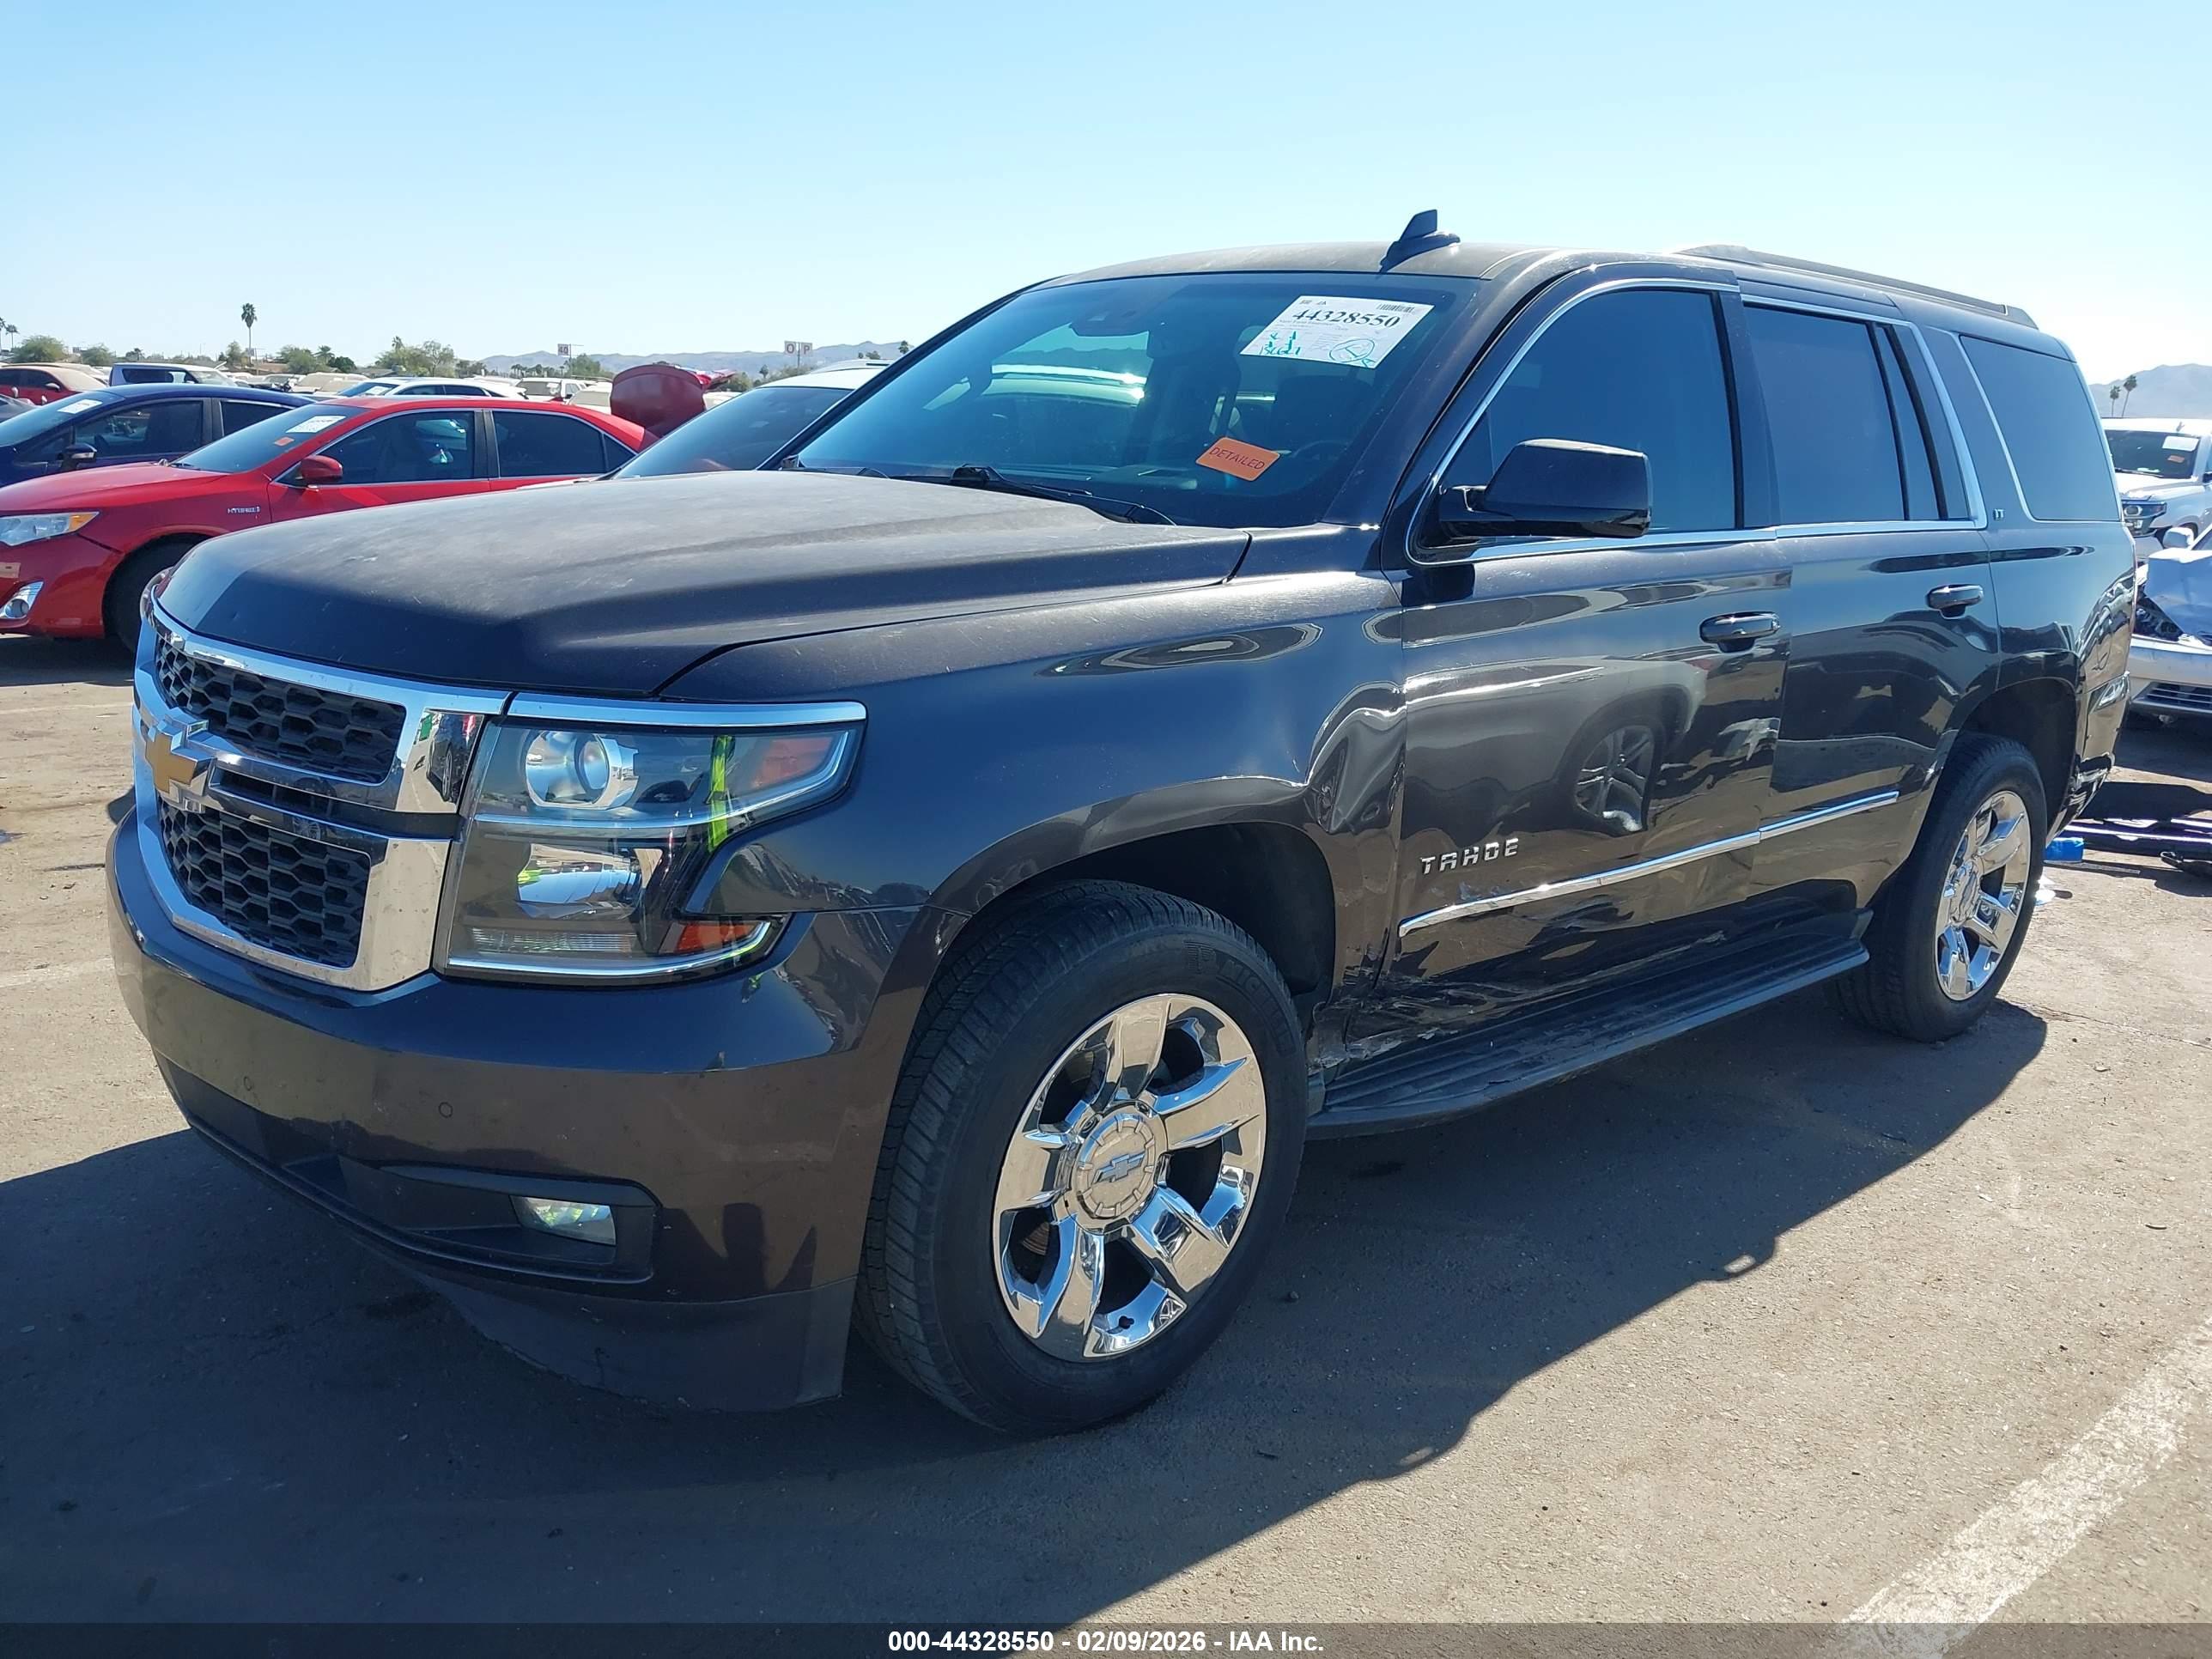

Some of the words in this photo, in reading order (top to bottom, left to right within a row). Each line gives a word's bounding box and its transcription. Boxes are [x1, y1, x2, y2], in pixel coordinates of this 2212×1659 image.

[1292, 308, 1401, 328] 44328550
[804, 344, 811, 355] P
[1208, 446, 1266, 470] DETAILED
[1420, 836, 1519, 875] TAHOE
